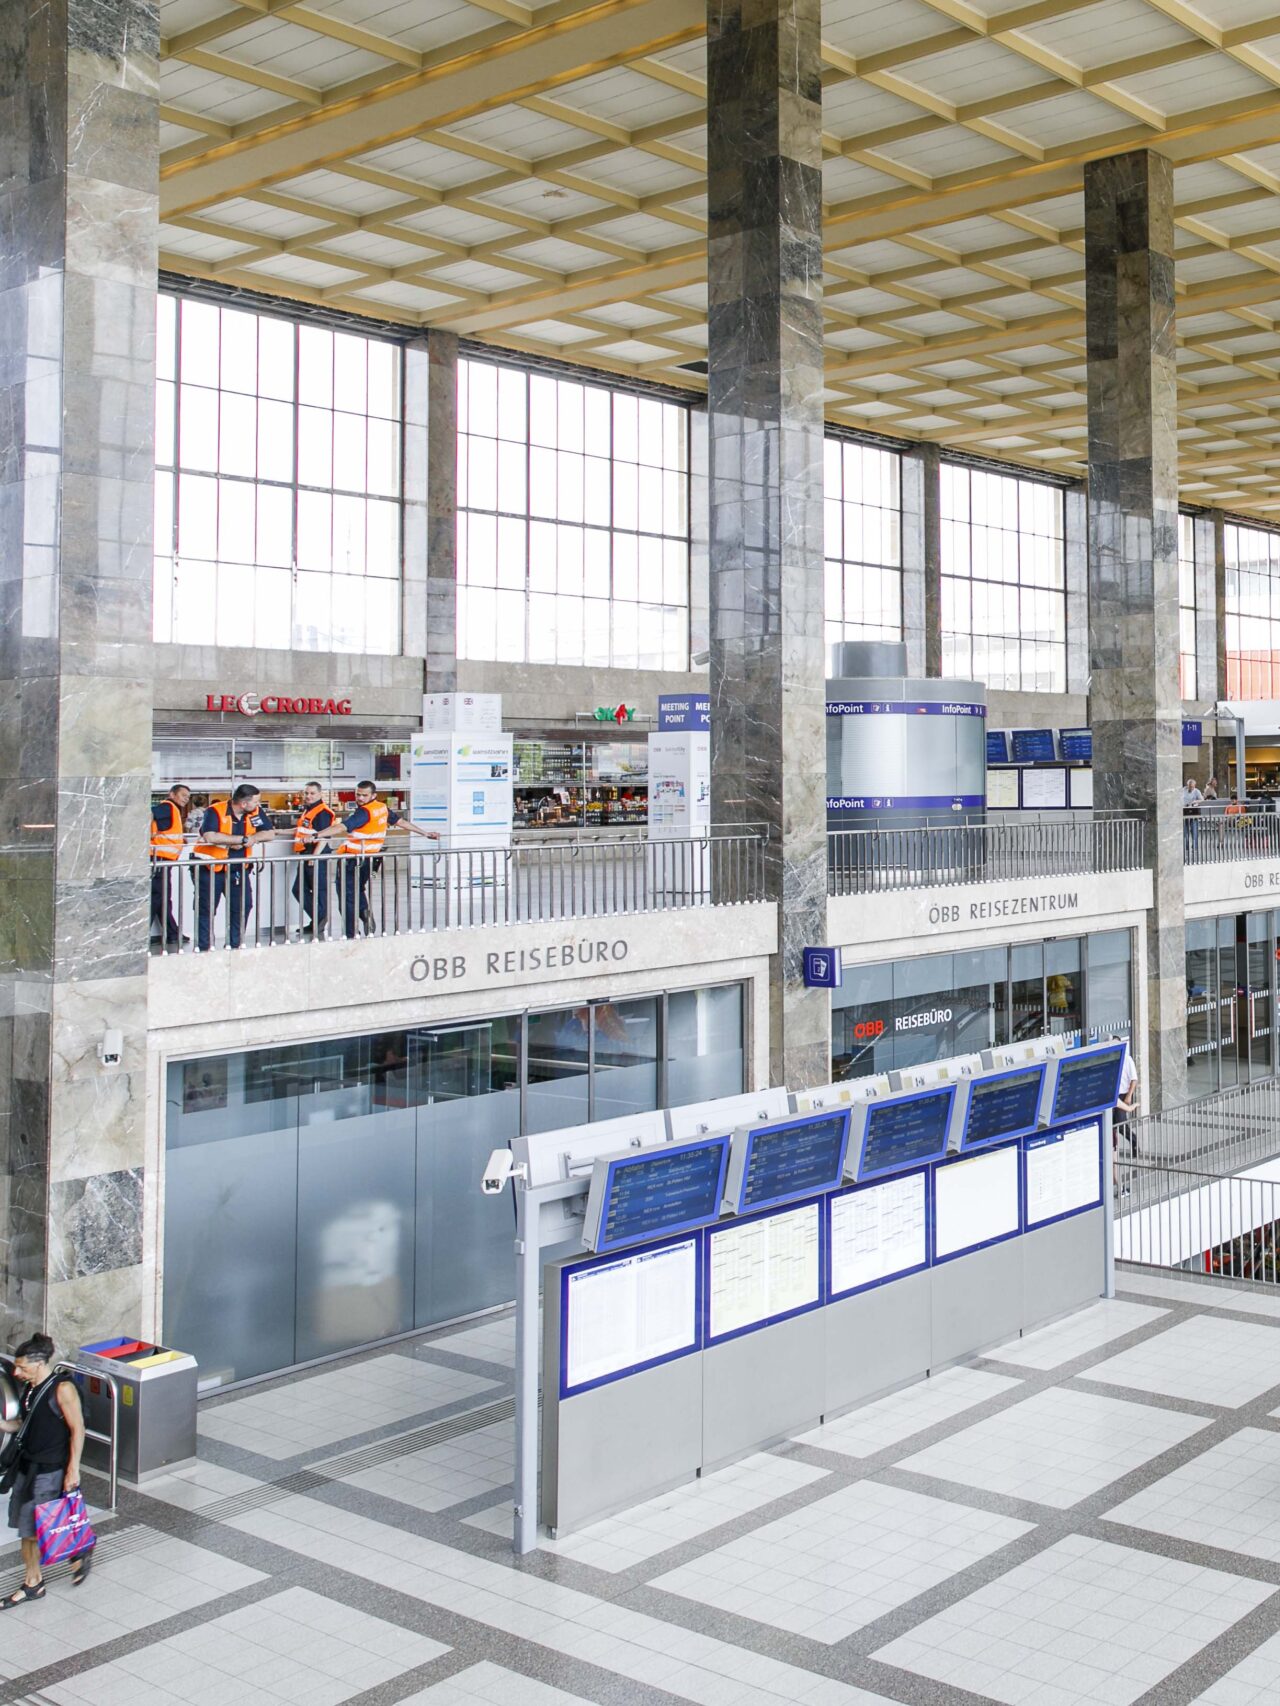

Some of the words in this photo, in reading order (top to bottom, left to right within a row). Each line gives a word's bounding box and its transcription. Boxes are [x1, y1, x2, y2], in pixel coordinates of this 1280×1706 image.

[206, 694, 236, 712] LE
[260, 695, 352, 715] CROBAG
[661, 702, 690, 711] MEETING
[826, 703, 864, 713] nfoPoint
[942, 704, 972, 714] InfoPoint
[665, 715, 685, 723] POINT
[826, 799, 864, 808] nfoPoint
[1244, 872, 1264, 888] ÖBB
[928, 903, 960, 924] ÖBB
[970, 893, 1078, 919] REISEZENTRUM
[410, 955, 467, 982] ÖBB
[487, 938, 629, 975] REISEBÜRO
[895, 1008, 952, 1031] REISEBÜRO
